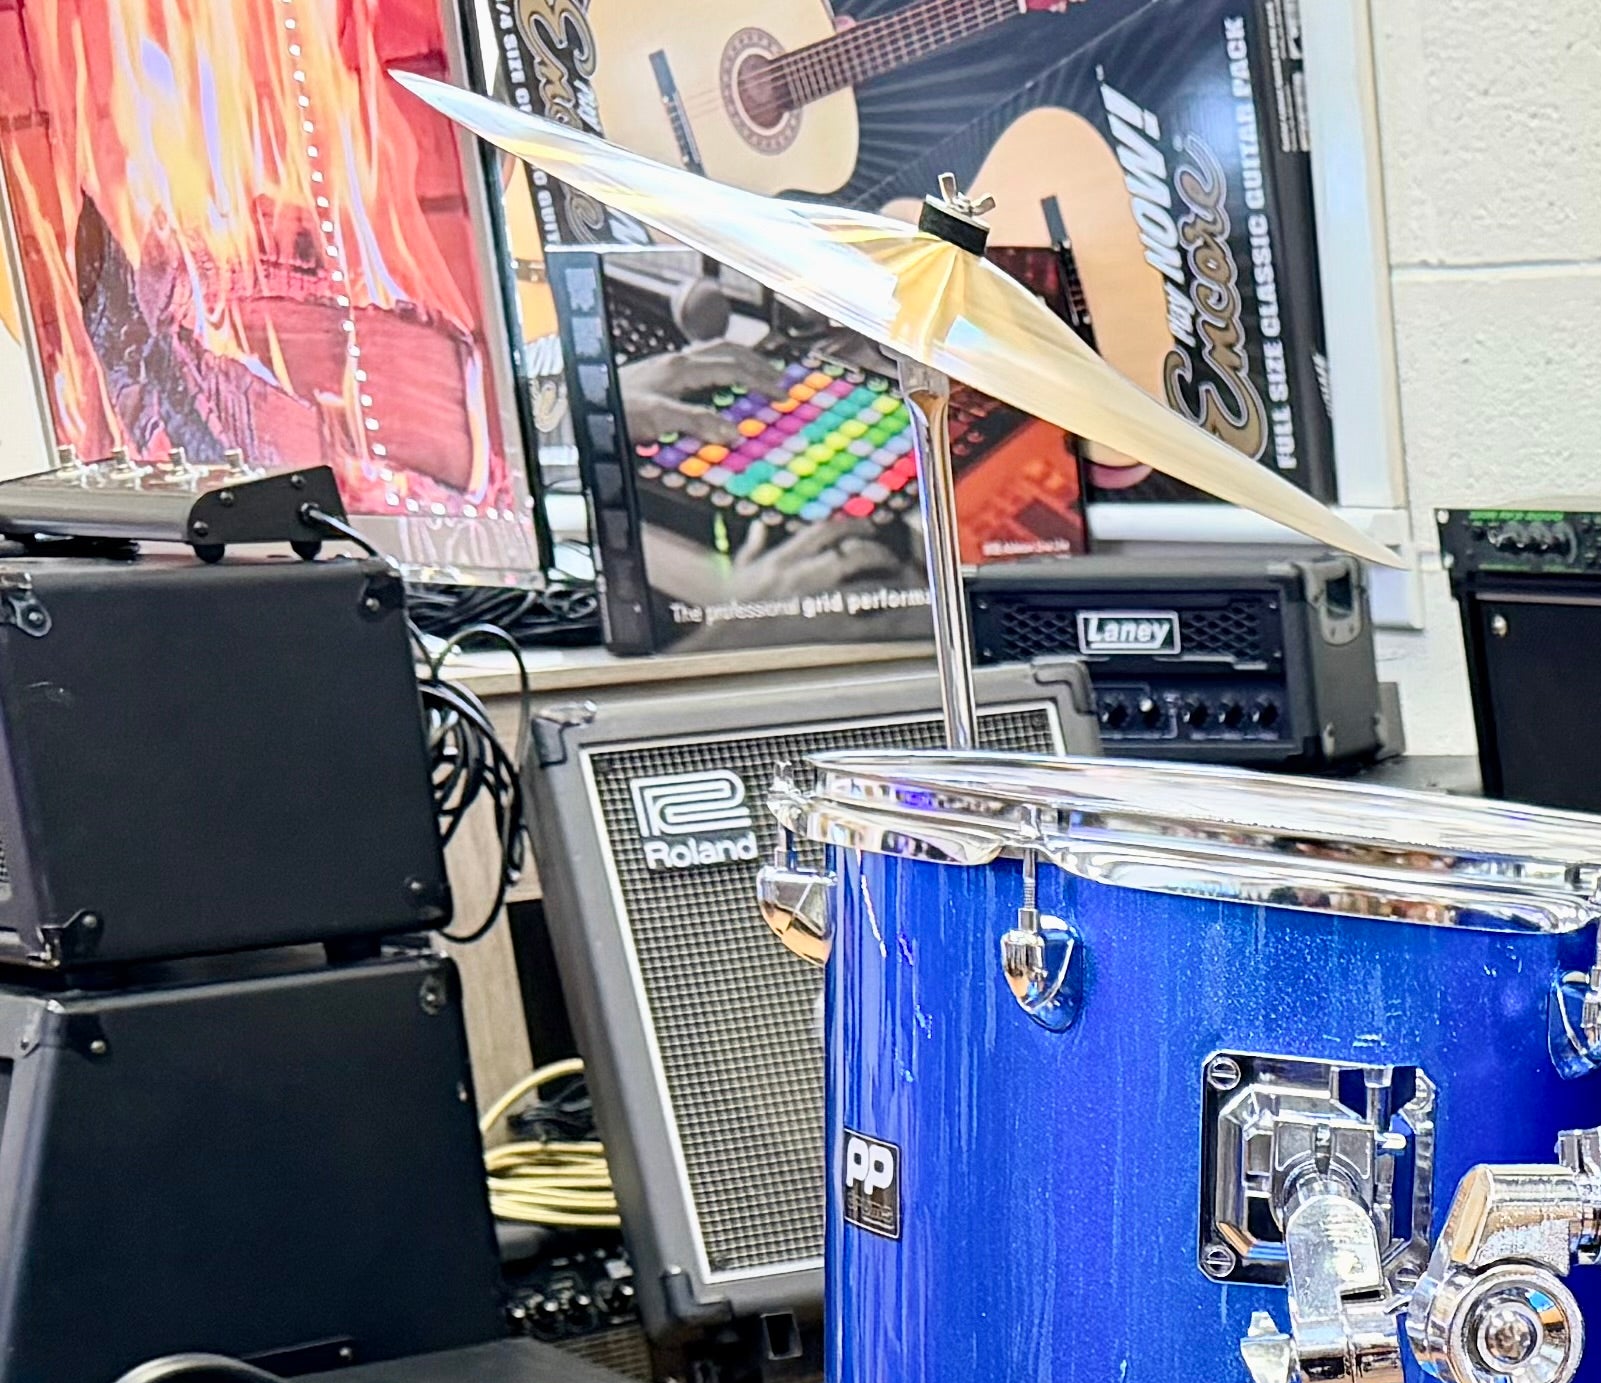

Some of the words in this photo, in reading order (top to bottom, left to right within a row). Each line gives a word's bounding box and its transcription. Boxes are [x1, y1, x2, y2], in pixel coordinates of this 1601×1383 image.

[1223, 16, 1253, 98] PACK
[1235, 102, 1266, 211] GUITAR
[1163, 133, 1268, 462] Encore
[1248, 214, 1282, 338] CLASSIC
[1264, 337, 1290, 402] SIZE
[1274, 405, 1299, 471] FULL
[673, 601, 703, 625] The
[704, 595, 800, 628] professional
[800, 590, 843, 619] grid
[846, 588, 933, 617] perform
[1087, 617, 1171, 648] Laney
[643, 831, 759, 870] Roland
